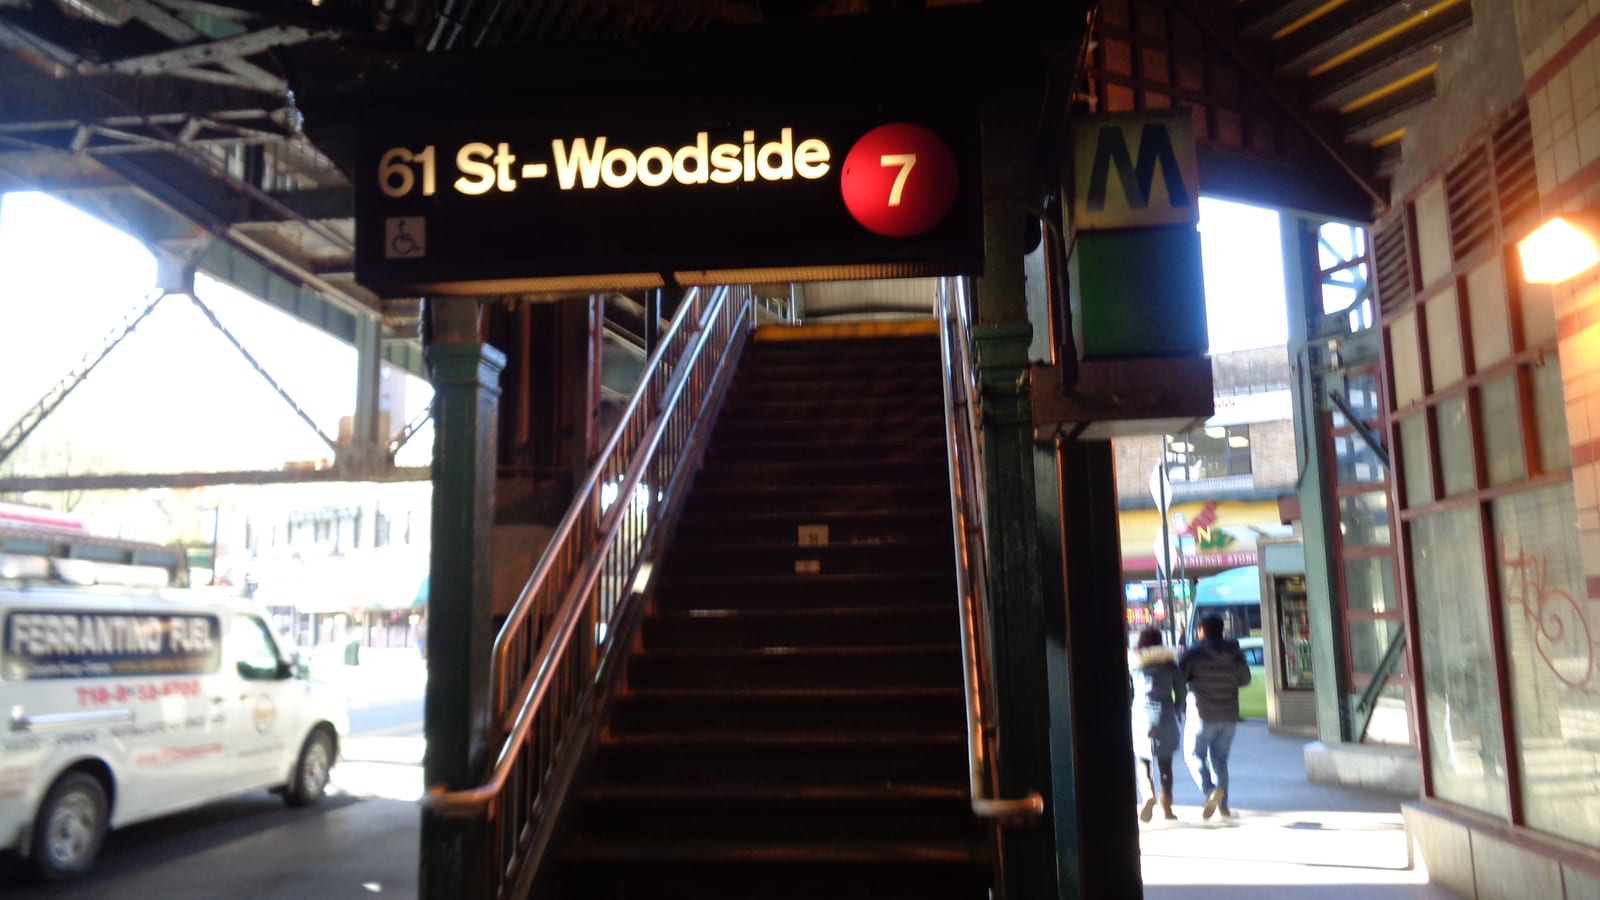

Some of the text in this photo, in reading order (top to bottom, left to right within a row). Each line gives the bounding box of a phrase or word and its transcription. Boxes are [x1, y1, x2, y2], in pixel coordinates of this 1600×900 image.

[378, 146, 436, 199] 61
[880, 153, 917, 207] 7
[11, 613, 214, 656] FERRANTINO FUEL
